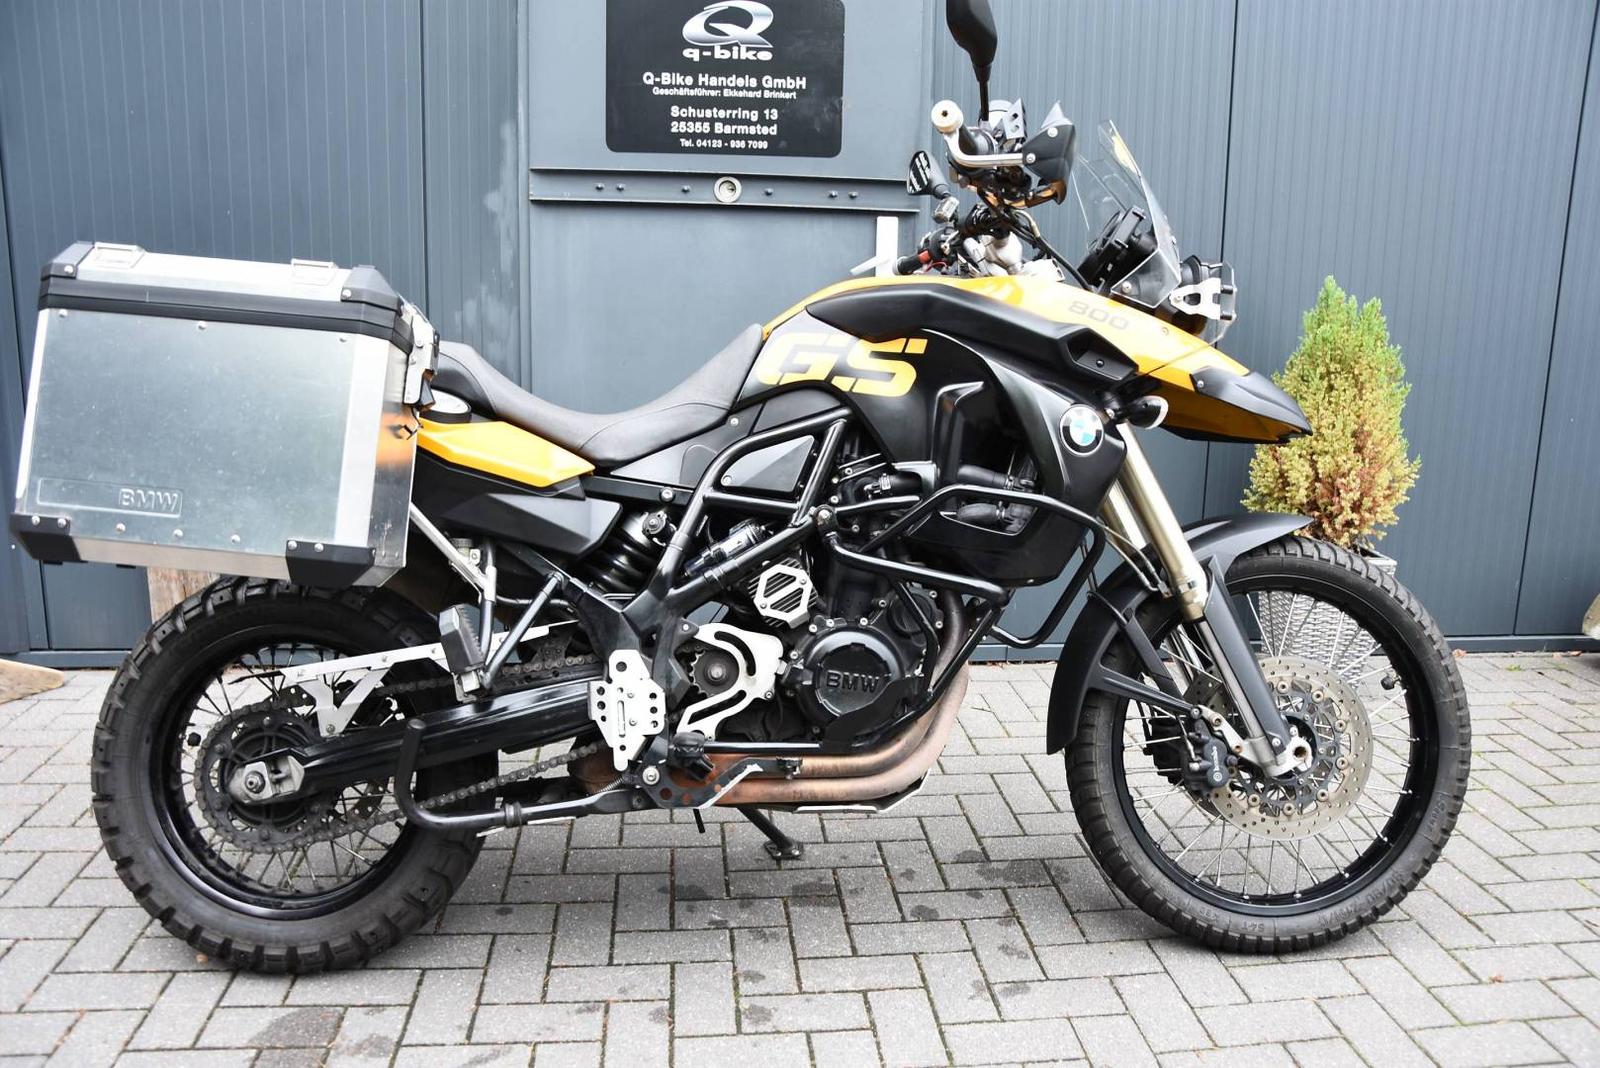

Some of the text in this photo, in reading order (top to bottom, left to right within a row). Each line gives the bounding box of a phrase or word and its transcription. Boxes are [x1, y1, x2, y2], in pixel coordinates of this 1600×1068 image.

[682, 46, 773, 61] q-bike
[642, 71, 807, 89] Q-Bike Handels GmbH
[652, 86, 721, 96] Geschäftsführer:
[723, 88, 762, 98] Ekkehard
[671, 105, 778, 121] Schusterring 13
[671, 121, 778, 135] 25355 Barmsted
[680, 138, 694, 147] Tel.
[696, 139, 723, 148] 04123
[1068, 300, 1129, 330] 800
[756, 331, 928, 397] GS
[118, 487, 179, 513] BMW
[826, 669, 880, 693] BMW
